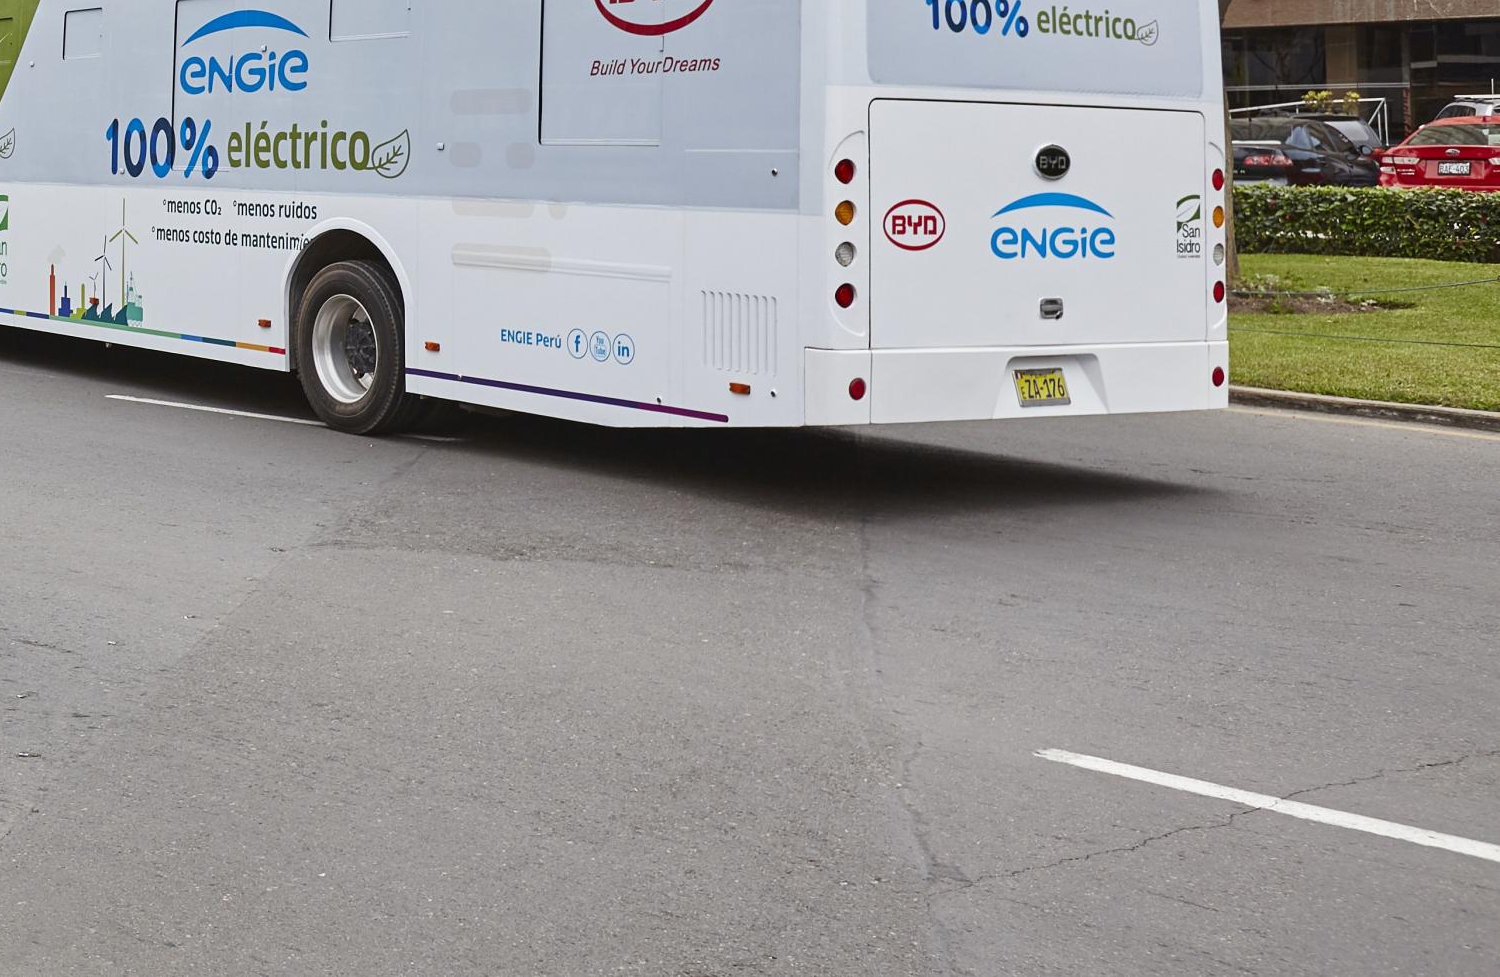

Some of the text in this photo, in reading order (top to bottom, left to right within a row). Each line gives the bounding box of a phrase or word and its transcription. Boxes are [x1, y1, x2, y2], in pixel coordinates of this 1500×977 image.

[1036, 6, 1137, 40] eléctrico
[590, 56, 721, 76] Build Your Dreams
[105, 116, 371, 180] 100% eléctrico
[1039, 155, 1067, 169] BYD
[278, 201, 318, 220] ruidos
[891, 215, 938, 235] BYD
[1182, 223, 1201, 238] San
[192, 229, 222, 245] costo
[224, 229, 238, 246] de
[241, 232, 313, 251] mantenimie
[1176, 239, 1201, 253] Isidro
[500, 328, 562, 349] ENGIE Perú
